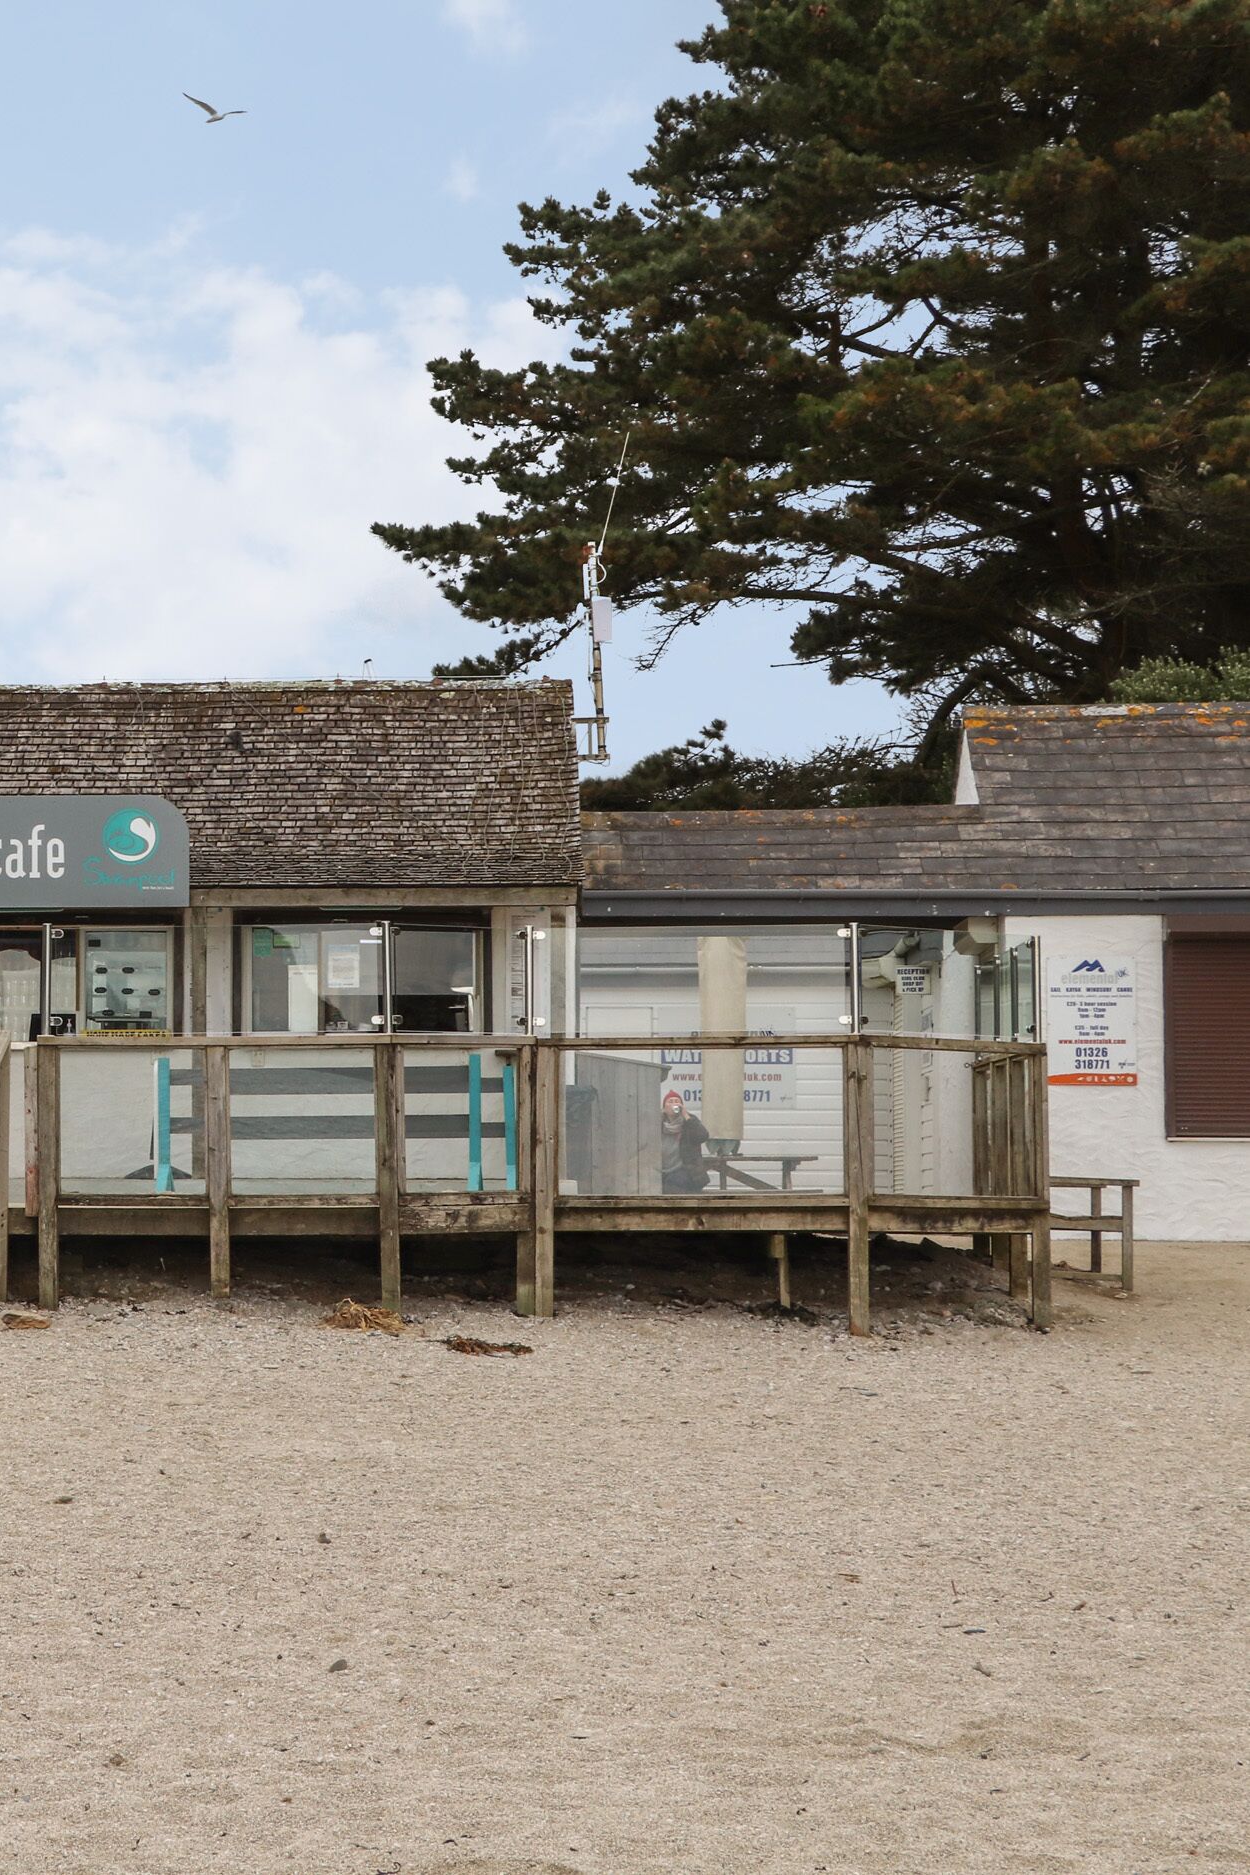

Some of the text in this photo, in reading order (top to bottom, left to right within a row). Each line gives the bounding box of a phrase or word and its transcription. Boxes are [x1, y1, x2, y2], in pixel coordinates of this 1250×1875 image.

[1061, 973, 1118, 985] elemental
[1075, 1047, 1108, 1057] 01326
[1074, 1059, 1110, 1069] 318771
